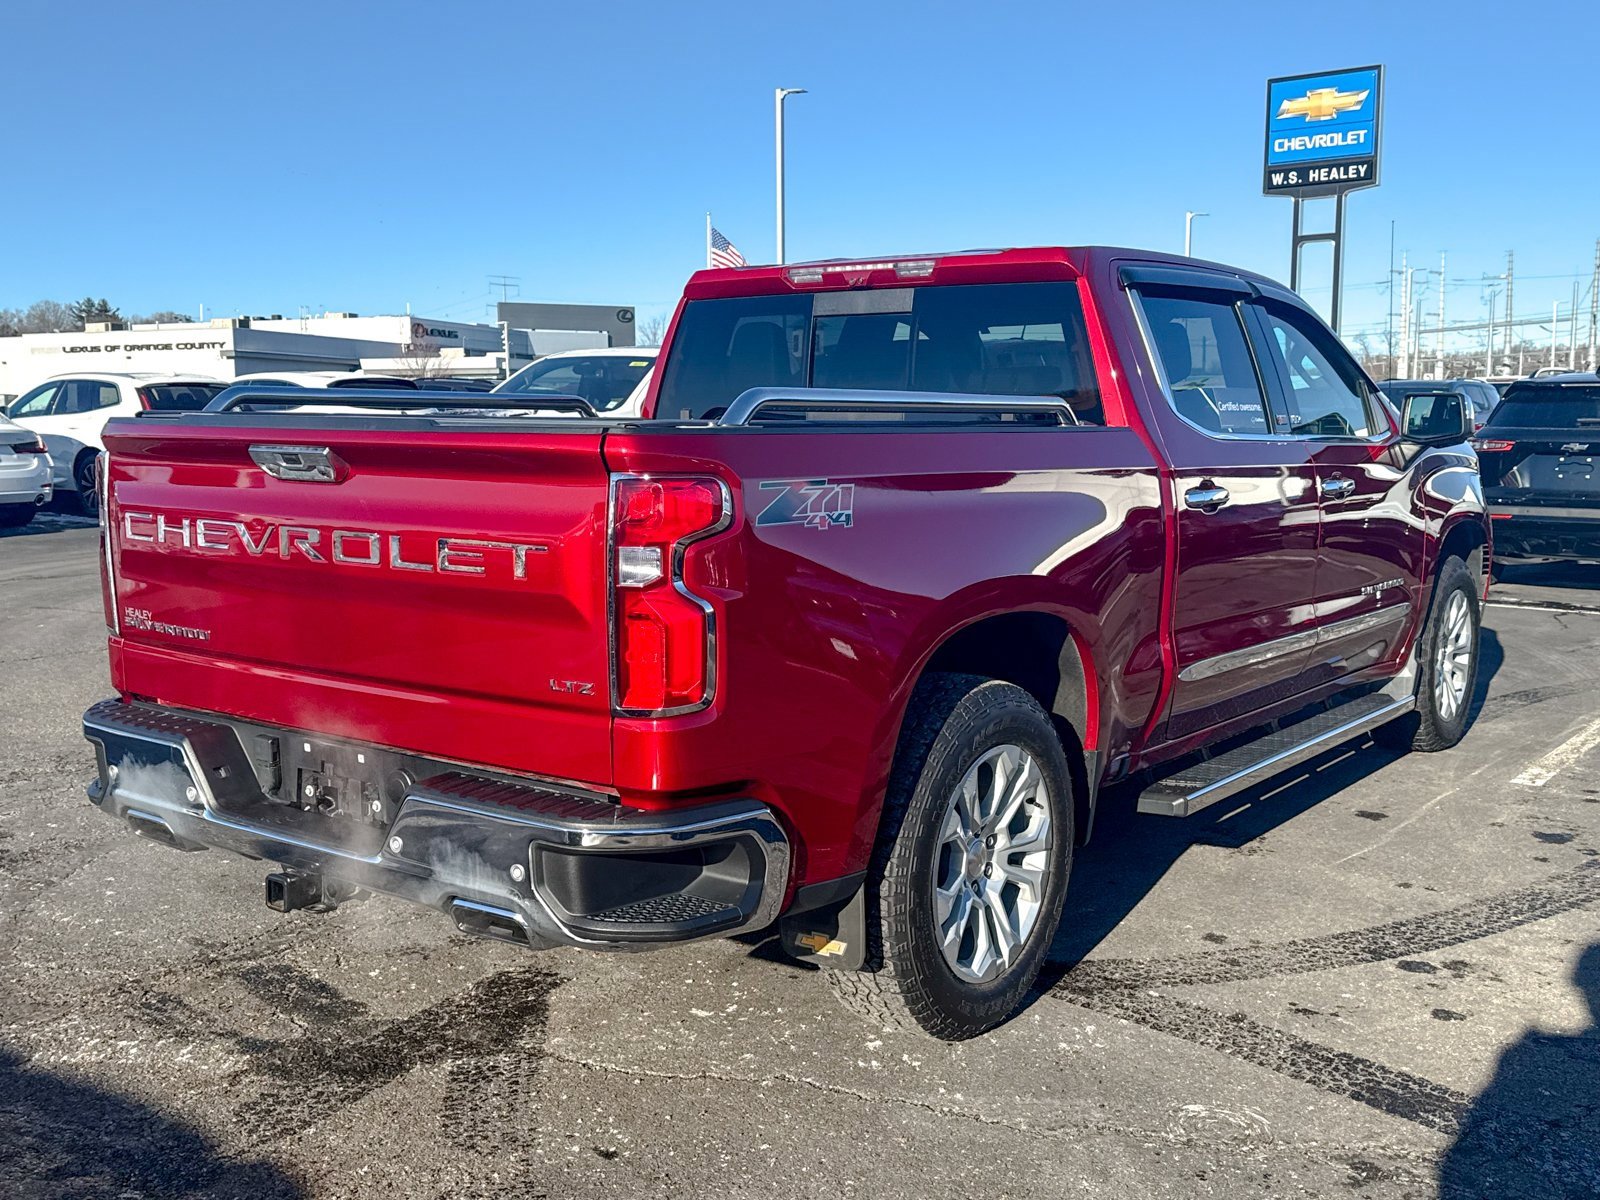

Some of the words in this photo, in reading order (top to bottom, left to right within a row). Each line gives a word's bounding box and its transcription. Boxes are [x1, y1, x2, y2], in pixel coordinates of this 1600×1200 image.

[1274, 130, 1368, 153] CHEVROLET
[1271, 171, 1302, 186] W.S.
[1309, 164, 1367, 182] HEALEY
[62, 345, 101, 353] LEXUS
[104, 344, 121, 353] OF
[124, 343, 173, 352] ORANGE
[176, 341, 226, 350] COUNTY
[756, 478, 854, 527] Z71
[124, 511, 549, 580] CHEVROLET
[125, 607, 152, 620] HEALEY
[549, 679, 595, 696] LTZ
